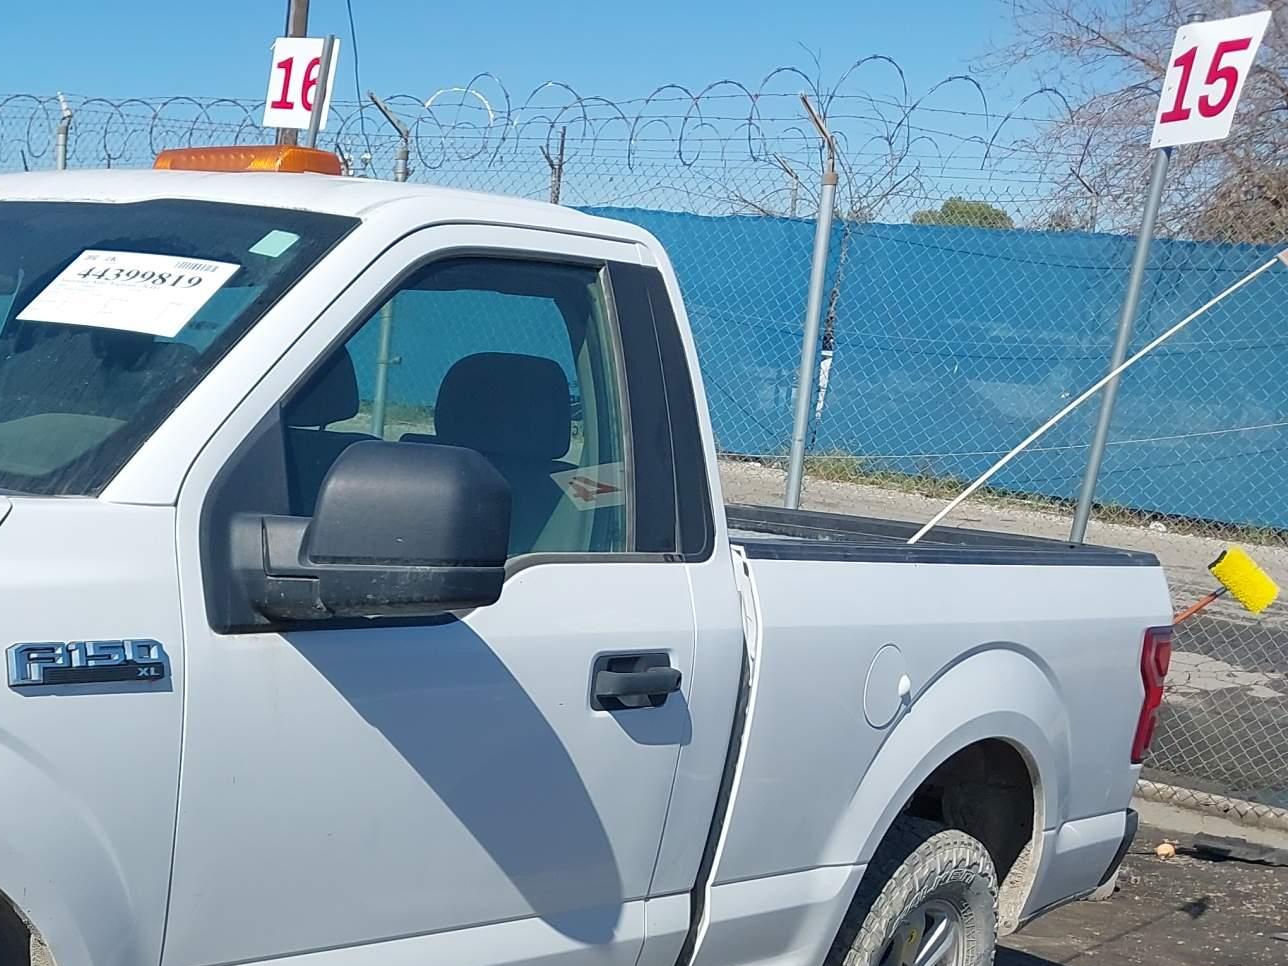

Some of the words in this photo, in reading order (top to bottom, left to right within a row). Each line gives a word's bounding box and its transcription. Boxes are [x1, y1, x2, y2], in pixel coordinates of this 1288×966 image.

[271, 56, 321, 112] 16
[1159, 37, 1253, 124] 15
[77, 266, 203, 289] 44399819
[137, 667, 161, 677] XL
